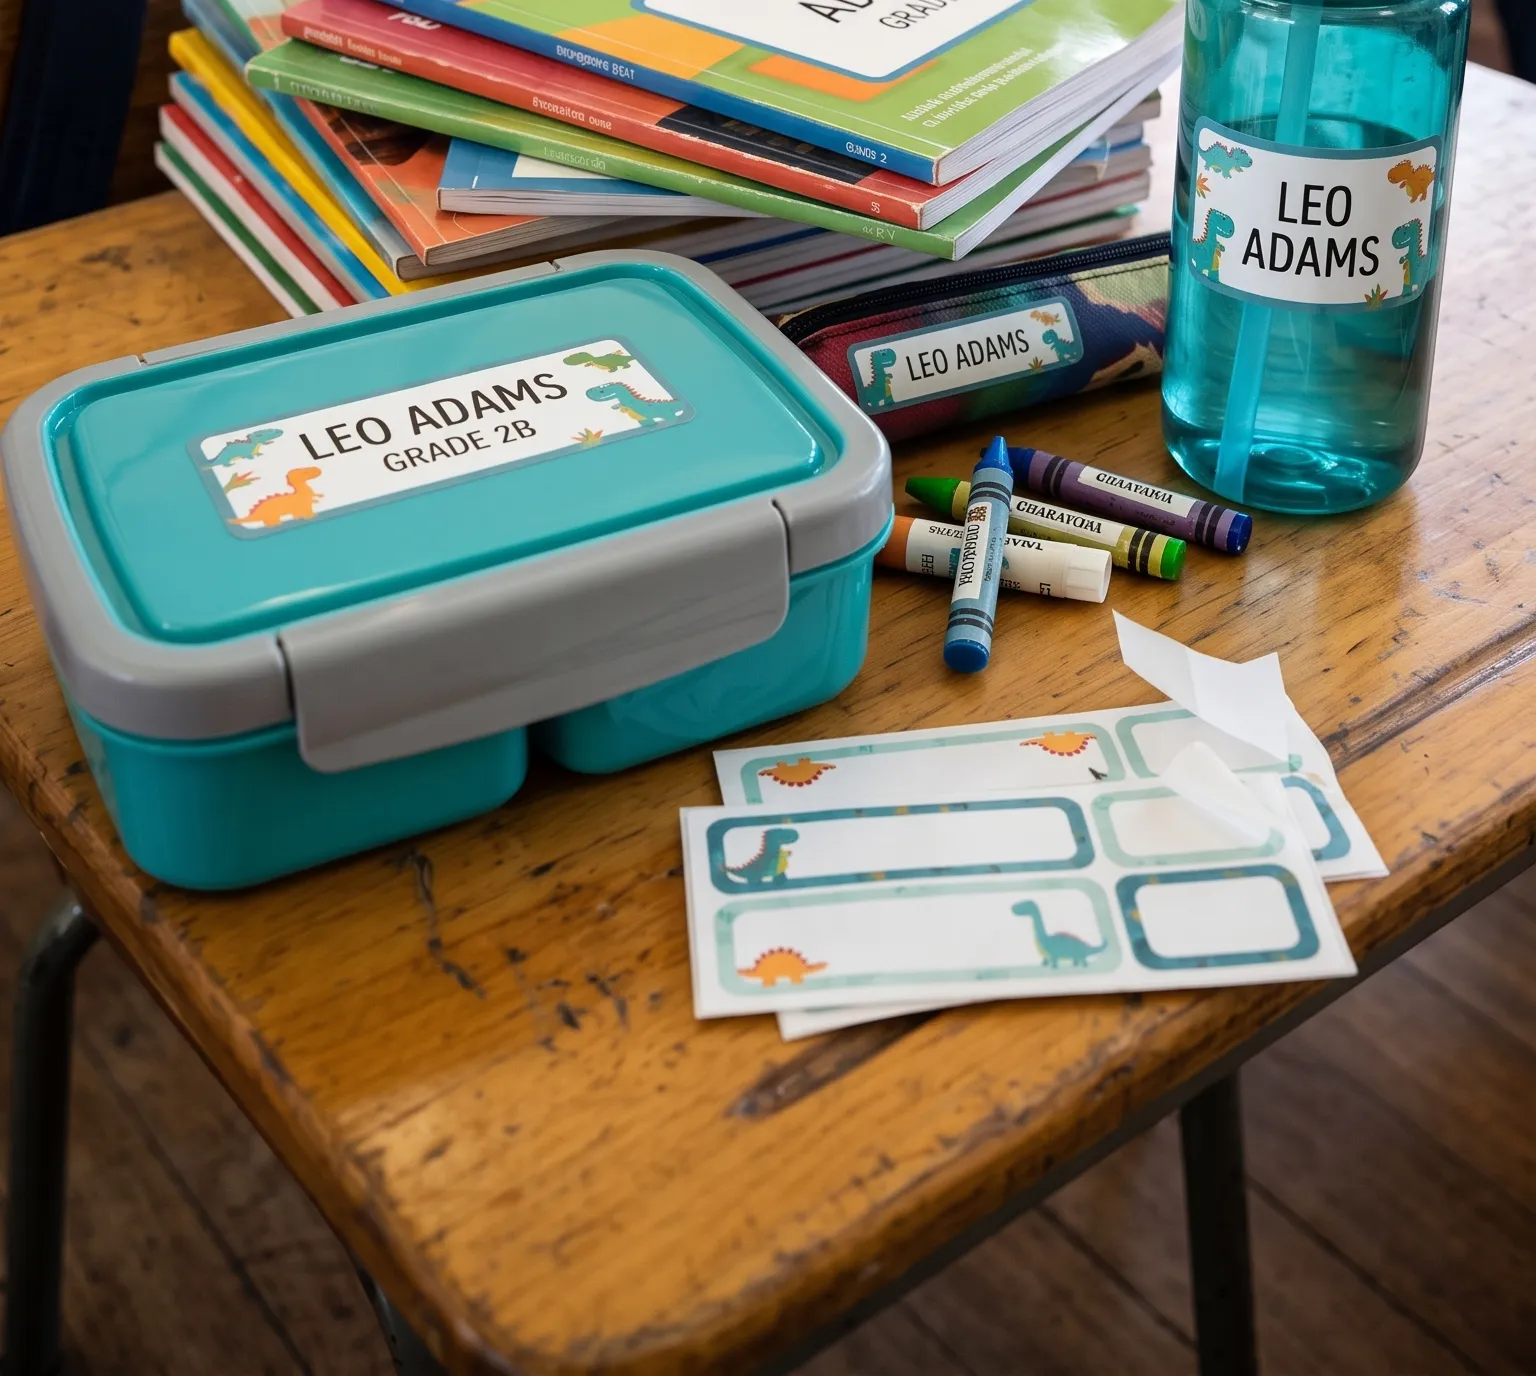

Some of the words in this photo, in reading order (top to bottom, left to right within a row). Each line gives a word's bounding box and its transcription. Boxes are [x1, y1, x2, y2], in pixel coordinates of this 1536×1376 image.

[1278, 181, 1352, 227] LEO
[1242, 227, 1380, 278] ADAMS
[905, 348, 949, 381] LEO
[956, 329, 1030, 370] ADAMS
[298, 416, 392, 461] LEO
[407, 373, 568, 436] ADAMS
[382, 429, 492, 473] GRADE
[493, 419, 537, 445] 2B
